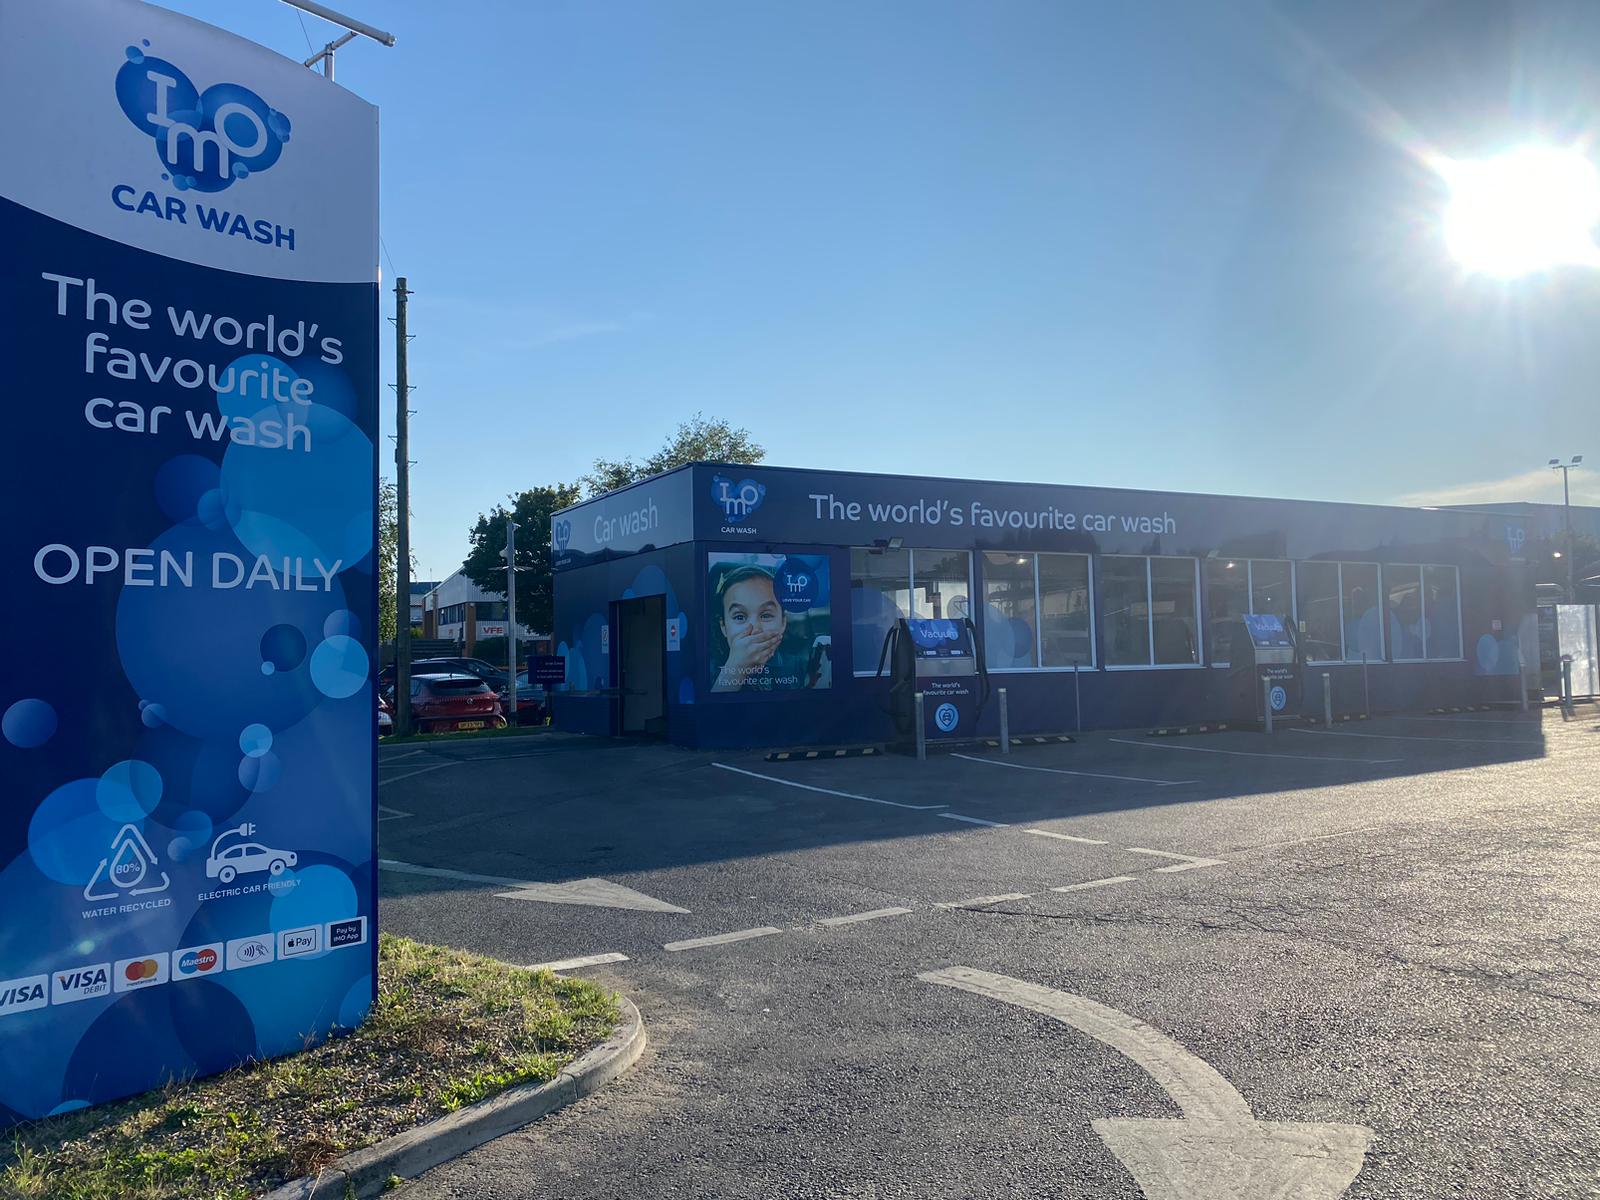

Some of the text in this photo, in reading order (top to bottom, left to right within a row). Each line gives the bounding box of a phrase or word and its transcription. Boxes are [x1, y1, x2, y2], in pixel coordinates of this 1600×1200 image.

[111, 184, 296, 251] CAR WASH
[41, 272, 344, 365] The world's
[85, 332, 314, 405] favourite
[84, 397, 312, 453] car wash
[594, 497, 658, 544] Car wash
[808, 493, 1176, 534] The world's favourite car wash
[33, 543, 344, 592] OPEN DAILY
[482, 626, 505, 634] VFE
[920, 629, 958, 638] Vacuum
[718, 664, 770, 674] The world's
[718, 675, 798, 686] favourite car wash
[115, 863, 140, 874] 80%
[198, 879, 301, 901] ELECTRIC CAR FRIENDLY
[82, 898, 171, 919] WATER RECYCLED
[296, 937, 312, 947] Pay
[181, 954, 215, 967] Maestro
[57, 969, 107, 991] VISA
[84, 984, 106, 995] DEBIT
